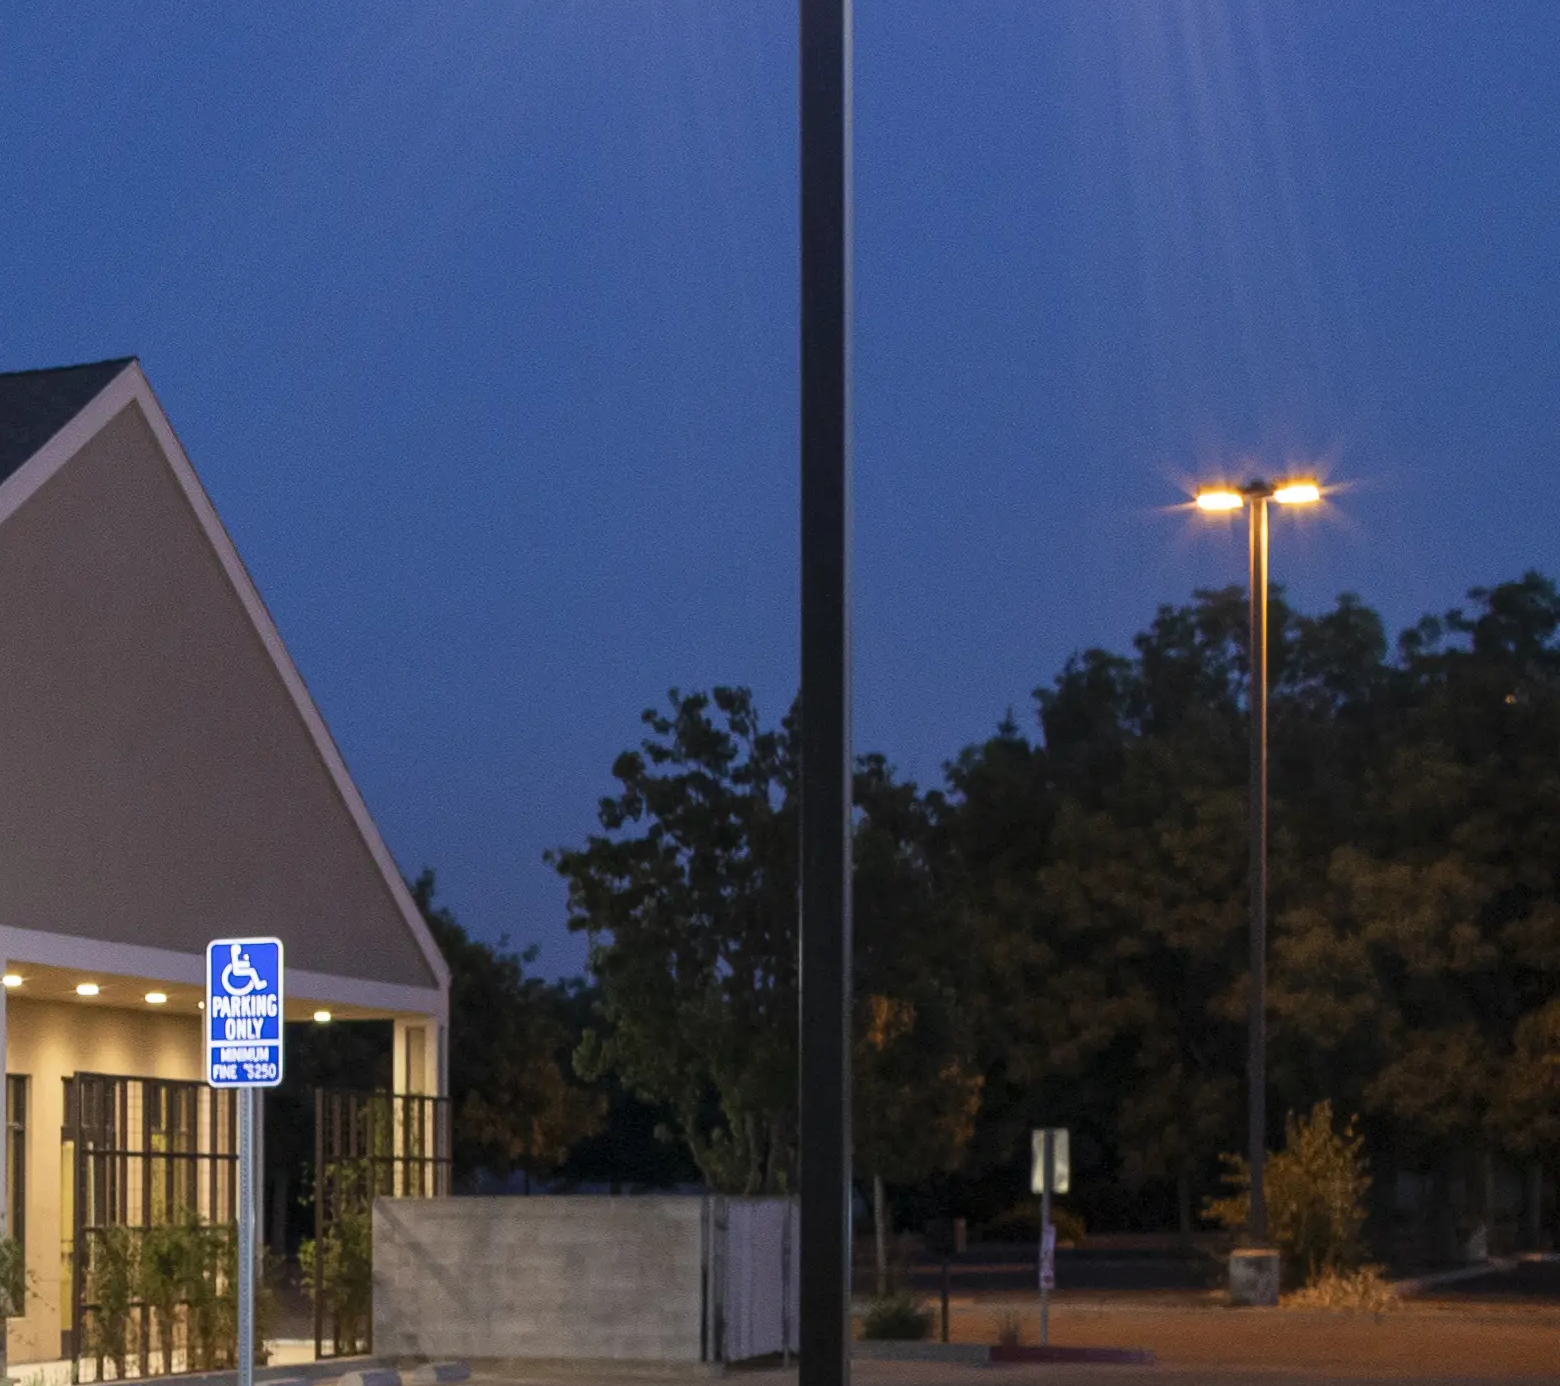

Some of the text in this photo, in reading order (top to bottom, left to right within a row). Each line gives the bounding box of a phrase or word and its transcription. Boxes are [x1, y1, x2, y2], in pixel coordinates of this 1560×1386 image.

[212, 994, 277, 1018] PARKING
[225, 1017, 264, 1040] ONLY
[220, 1046, 270, 1062] MINIMUM
[212, 1064, 238, 1080] FINE
